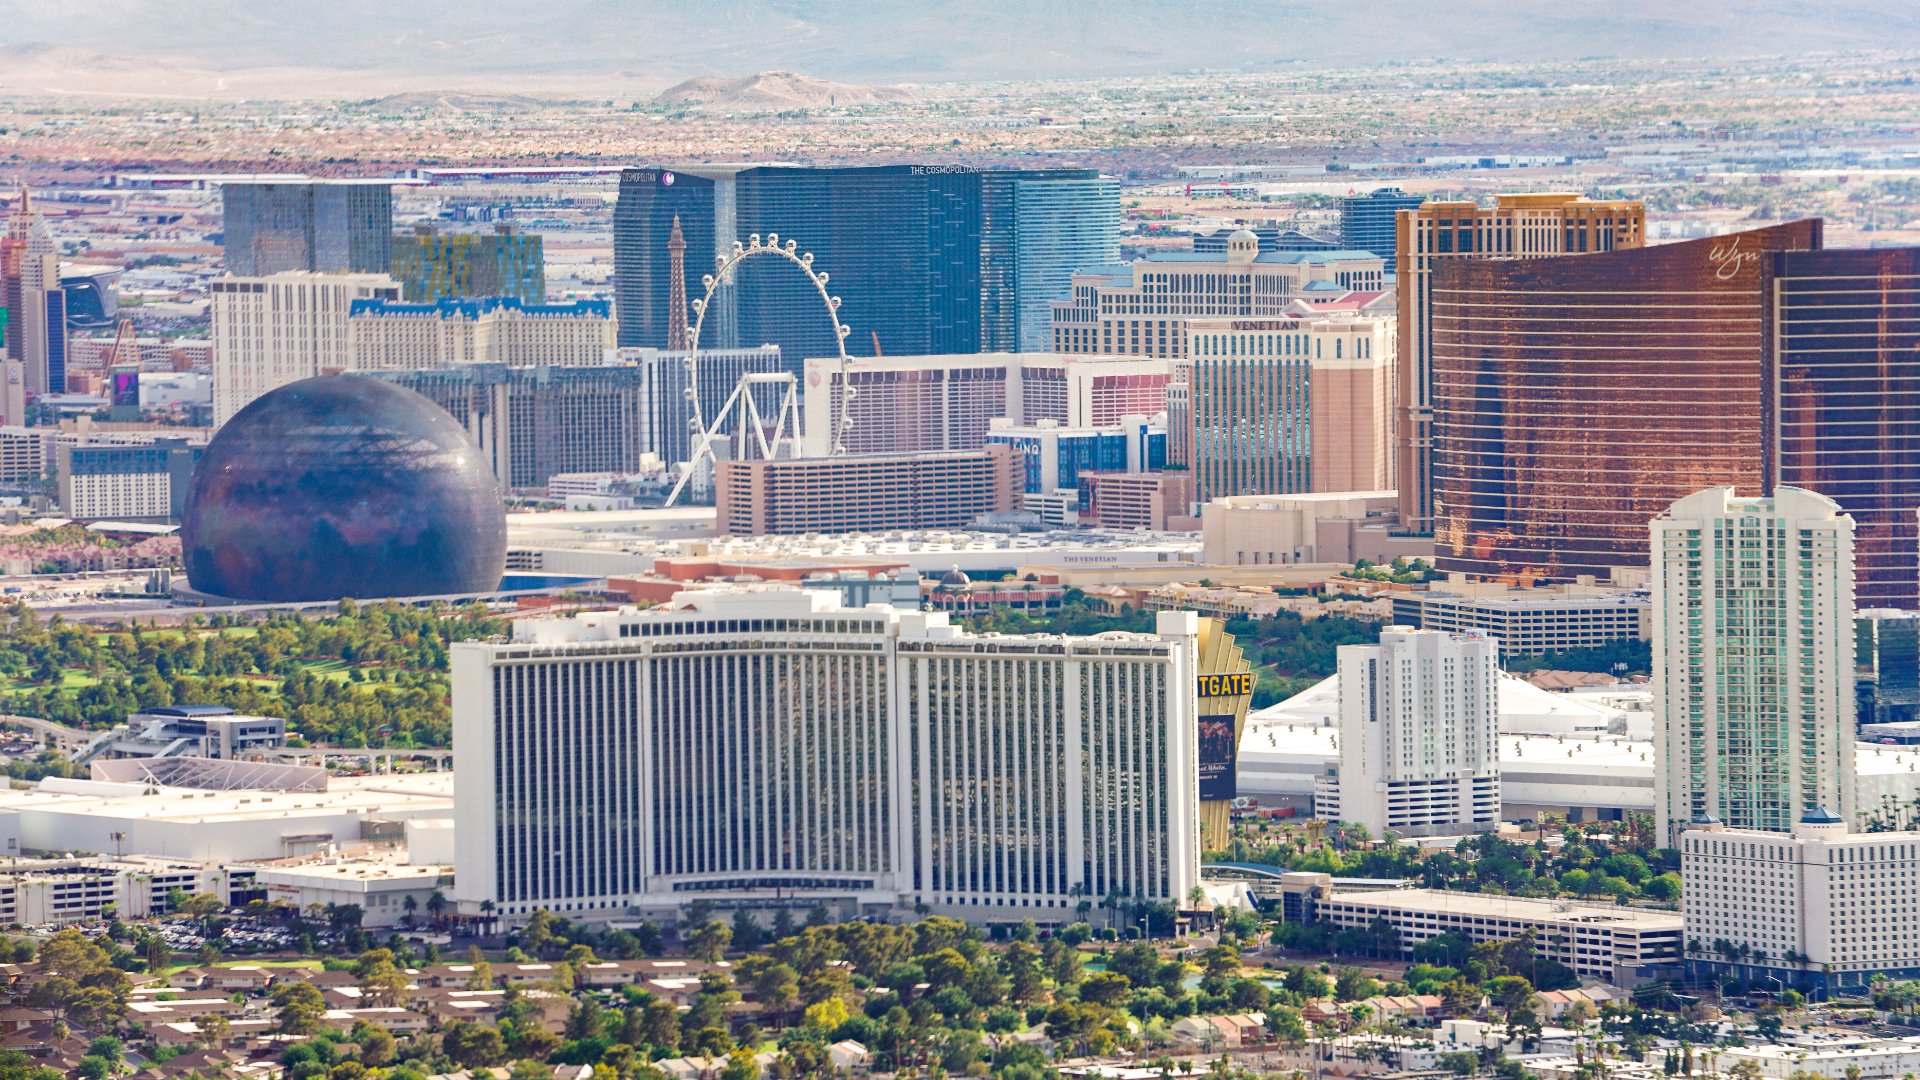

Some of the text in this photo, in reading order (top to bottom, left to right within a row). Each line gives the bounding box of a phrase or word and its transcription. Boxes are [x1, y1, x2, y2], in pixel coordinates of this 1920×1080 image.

[911, 165, 979, 175] THE COSMOPOLITAN
[622, 172, 656, 182] COSMOPOLITAN
[1709, 236, 1760, 279] Wyn
[1233, 321, 1299, 330] VENETIAN
[1199, 675, 1249, 696] TGATE
